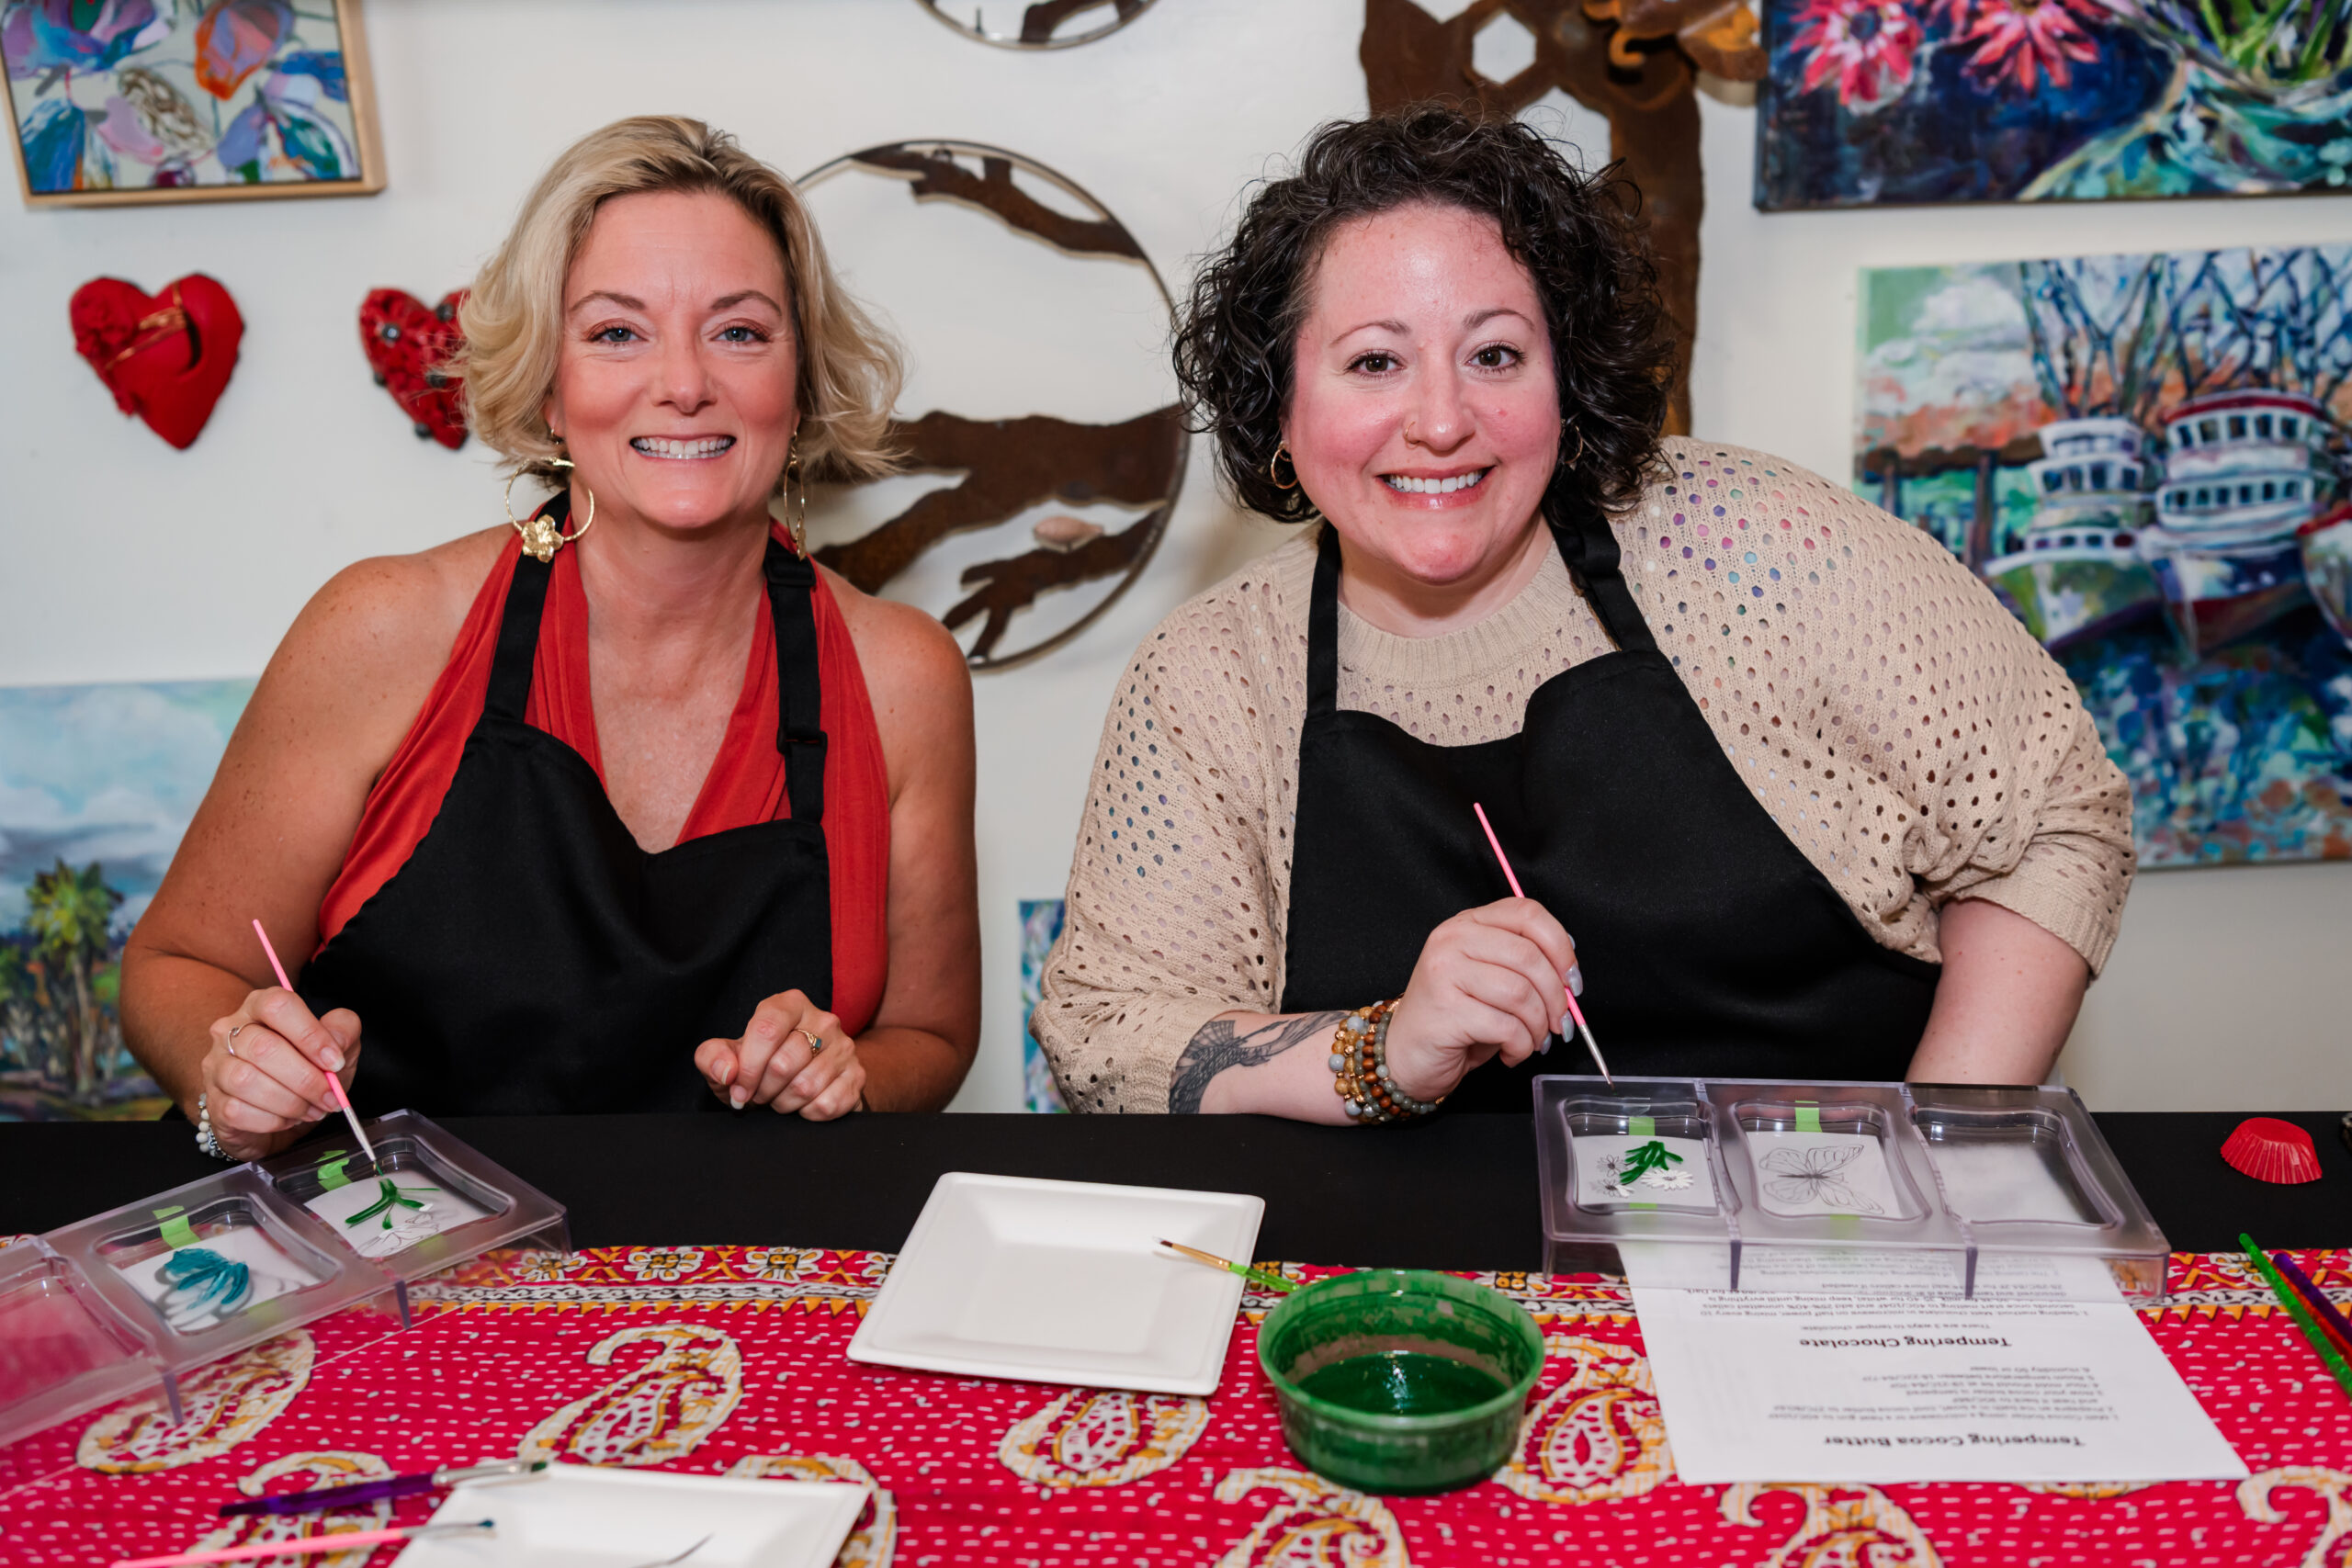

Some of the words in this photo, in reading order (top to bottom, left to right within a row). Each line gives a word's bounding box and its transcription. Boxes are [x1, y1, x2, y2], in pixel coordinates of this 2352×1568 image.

[1799, 1337, 1901, 1349] Chocolate
[1903, 1336, 2013, 1348] Tempering
[1824, 1436, 1892, 1448] Butter
[1896, 1435, 1964, 1448] Cocoa
[1967, 1433, 2086, 1447] Tempering
